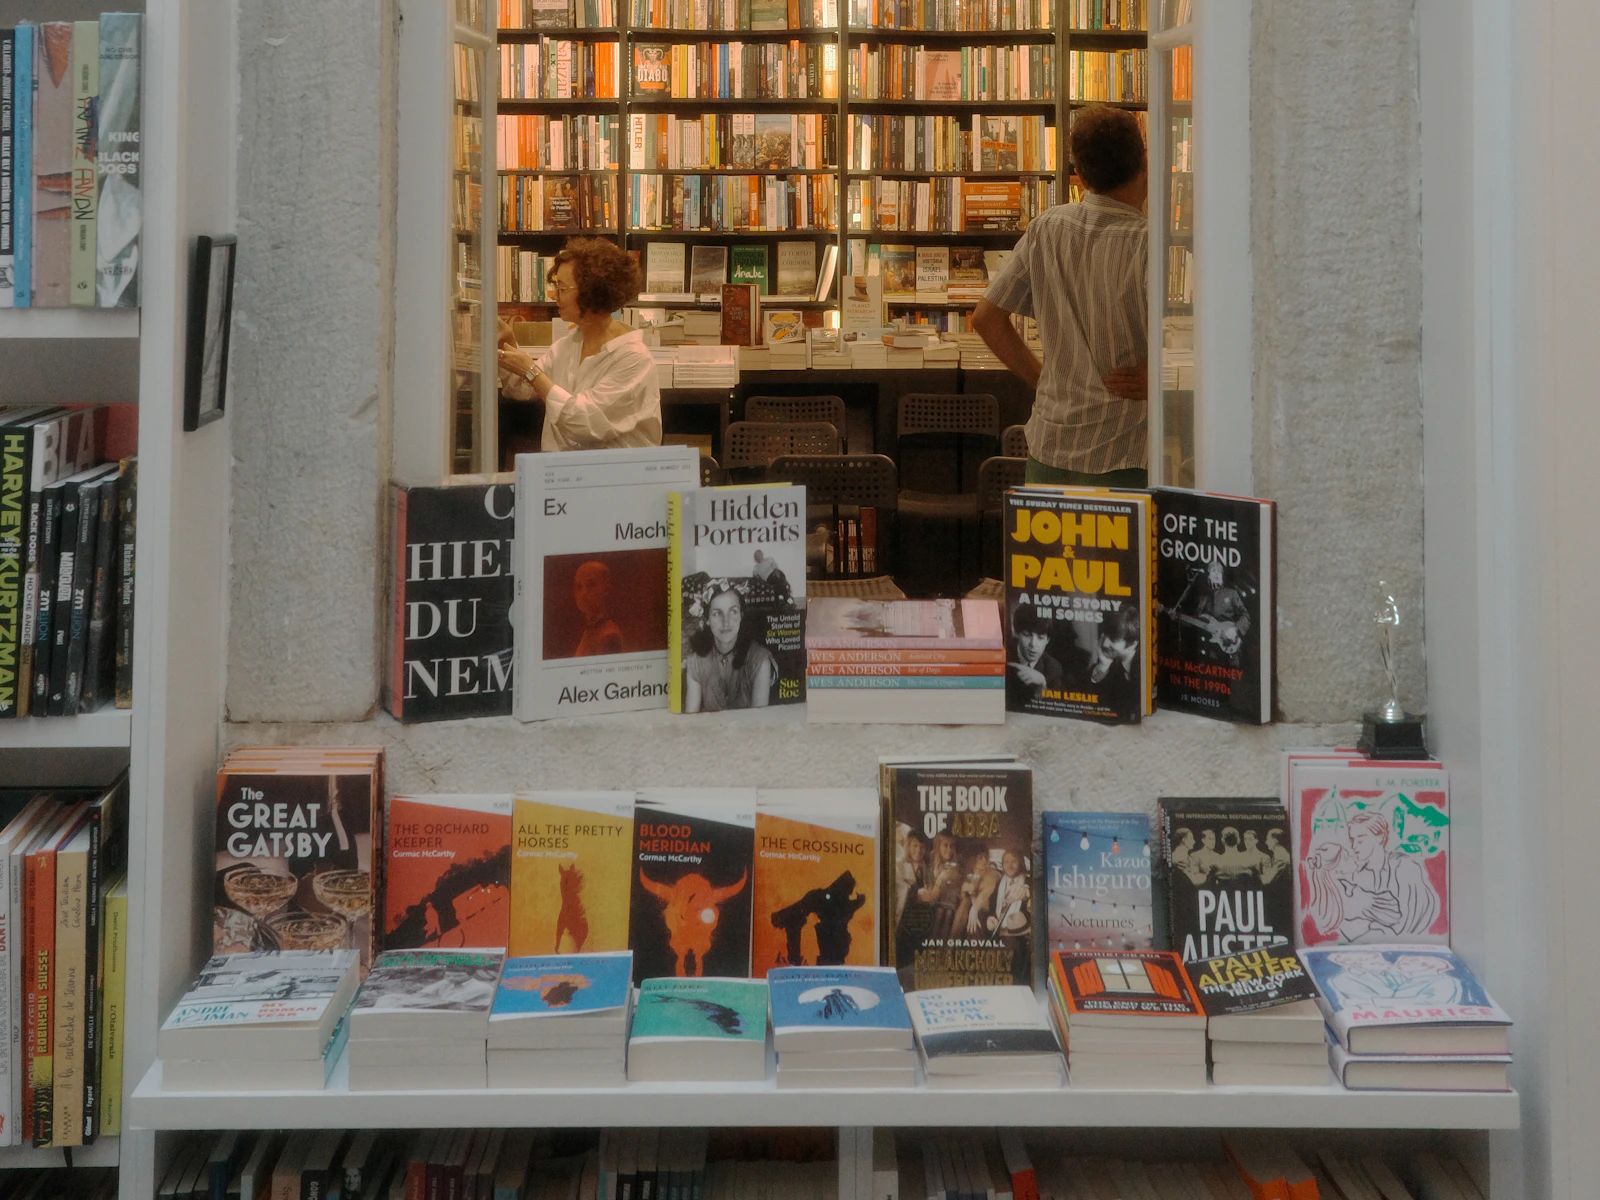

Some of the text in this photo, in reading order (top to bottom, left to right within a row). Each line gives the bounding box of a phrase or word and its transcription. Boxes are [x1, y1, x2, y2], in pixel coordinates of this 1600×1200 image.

[557, 41, 568, 97] Salazar
[637, 69, 668, 82] DIABO
[634, 117, 643, 149] HITLER
[733, 265, 765, 279] Árabe
[0, 433, 25, 545] HARVEY
[544, 499, 567, 516] Ex
[710, 494, 799, 522] Hidden
[1025, 500, 1057, 508] SUNDAY
[1059, 502, 1082, 510] TIMES
[1083, 504, 1131, 513] BESTSELLER
[28, 502, 39, 562] BLACK DOGS
[693, 520, 800, 547] Portraits
[1011, 509, 1128, 550] JOHN
[1163, 513, 1238, 542] OFF THE
[1062, 545, 1075, 558] &
[1160, 538, 1241, 568] GROUND
[1011, 554, 1131, 596] PAUL
[26, 577, 34, 591] HO
[1019, 592, 1122, 612] A LOVE STORY
[405, 598, 482, 641] DU
[767, 614, 800, 623] The Untold
[1037, 607, 1104, 624] IN SONGS
[0, 552, 21, 706] KURTZMAN
[771, 621, 792, 630] Stories
[22, 614, 33, 665] ANDERSON
[778, 643, 800, 651] Picasso
[811, 652, 901, 662] WES ANDERSON
[811, 665, 900, 675] WES ANDERSON
[1159, 657, 1244, 681] PAUL McCARTNEY
[780, 678, 799, 688] Sue
[810, 678, 900, 687] WES ANDERSON
[1170, 673, 1231, 695] IN THE 1990s
[779, 688, 799, 699] Roe
[1041, 689, 1098, 703] IAN LESLIE
[1376, 777, 1441, 787] E M FORSTER
[240, 787, 264, 801] The
[917, 785, 1008, 812] THE BOOK
[227, 803, 321, 829] GREAT
[394, 823, 490, 835] THE ORCHARD
[518, 824, 623, 837] ALL THE PRETTY
[639, 824, 692, 838] BLOOD
[924, 812, 947, 839] OF
[227, 832, 333, 858] GATSBY
[394, 837, 443, 849] KEEPER
[517, 837, 569, 849] HORSES
[639, 839, 711, 854] MERIDIAN
[760, 836, 865, 855] THE CROSSING
[393, 850, 456, 859] Cormac McCarthy
[516, 850, 579, 860] Cormac McCarthy
[639, 853, 703, 864] Cormac McCarthy
[760, 850, 821, 863] Cormac McCarthy
[1100, 852, 1151, 869] Kazuo
[1051, 865, 1151, 897] Ishiguro
[1198, 890, 1273, 933] PAUL
[1060, 913, 1134, 928] Nocturnes
[921, 939, 1005, 948] JAN GRADVALL
[914, 950, 1014, 971] MELANCHOLY
[1208, 949, 1279, 973] PAUL
[1199, 956, 1301, 989] AUSTER
[1200, 969, 1305, 995] THE NEW YORK
[1225, 980, 1285, 998] TRILOGY
[37, 950, 49, 1054] ROBINSON SUISSE
[1352, 1008, 1494, 1021] MAURICE
[86, 1086, 94, 1108] fayard
